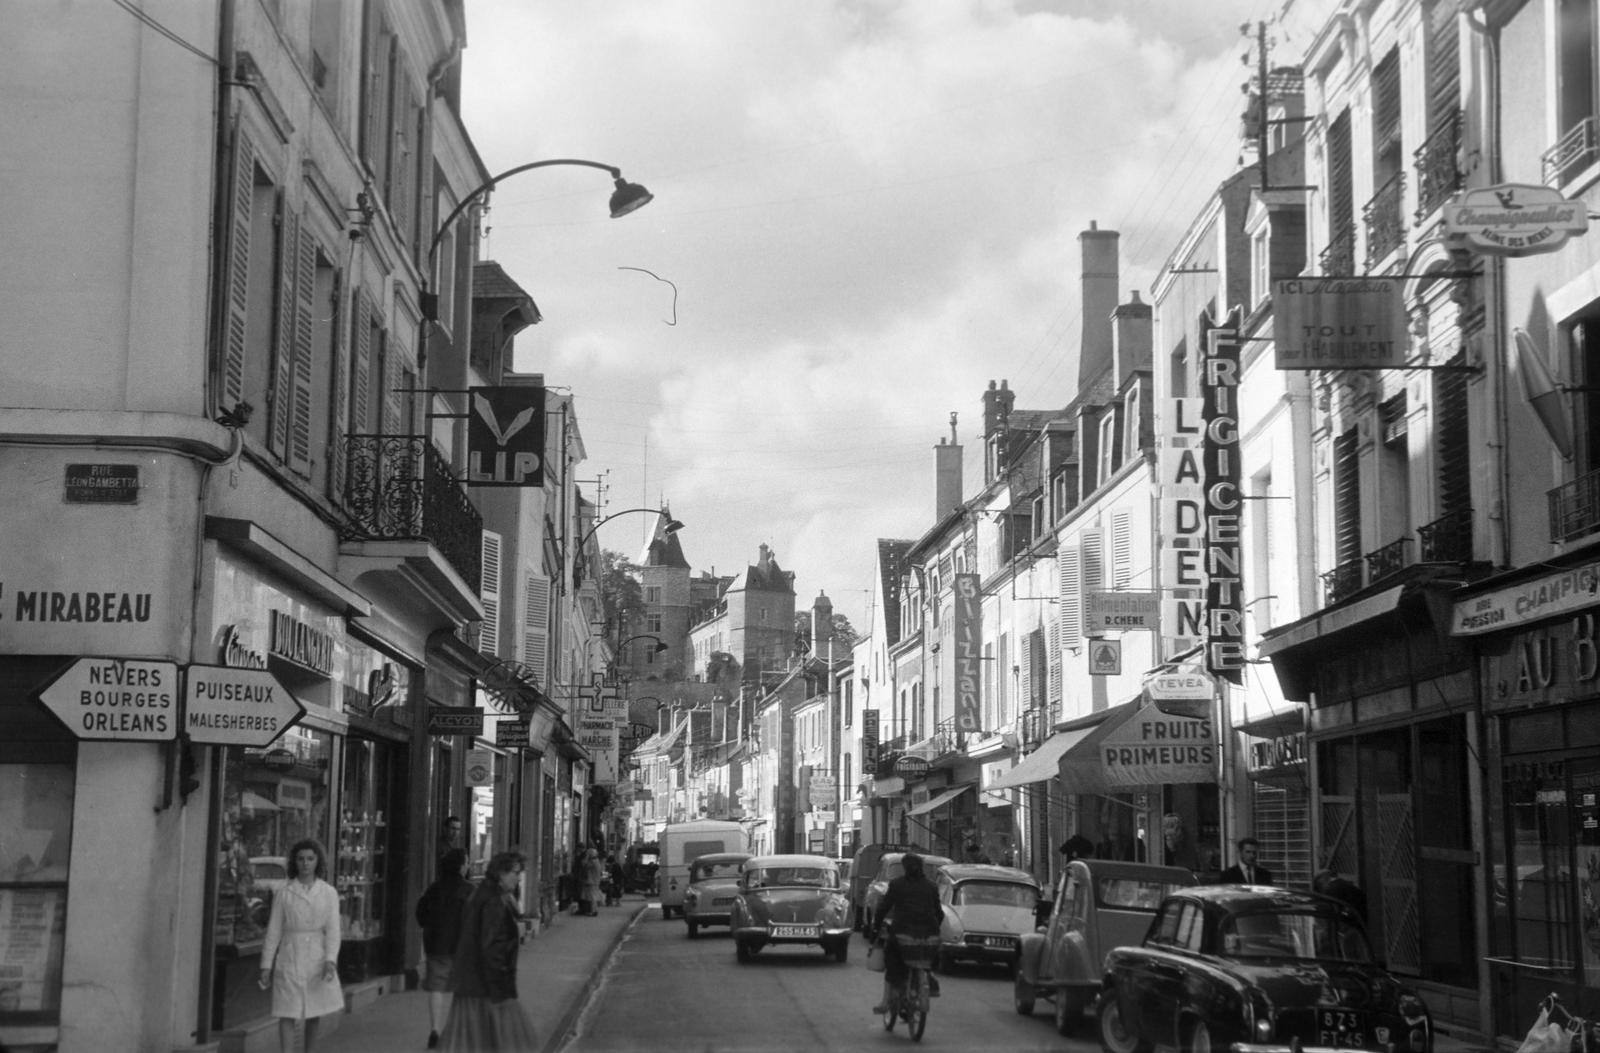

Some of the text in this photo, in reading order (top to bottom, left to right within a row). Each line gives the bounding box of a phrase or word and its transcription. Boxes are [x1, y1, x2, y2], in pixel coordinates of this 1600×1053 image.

[1280, 282, 1303, 295] ICI
[1303, 324, 1376, 337] TOUT
[91, 465, 113, 477] RUE
[470, 451, 540, 484] LIP
[1206, 327, 1242, 671] FRIGICENTRE
[1175, 398, 1203, 638] LADEN
[15, 590, 153, 624] MIRABEAU
[89, 666, 162, 687] NEVERS
[80, 690, 171, 709] BOURGES
[195, 681, 274, 704] PUISEAUX
[83, 712, 169, 733] ORLEANS
[189, 712, 279, 732] MALESHERBES
[428, 716, 483, 727] ALCYON
[1142, 721, 1213, 740] FRUITS
[1106, 747, 1214, 767] PRIMEURS
